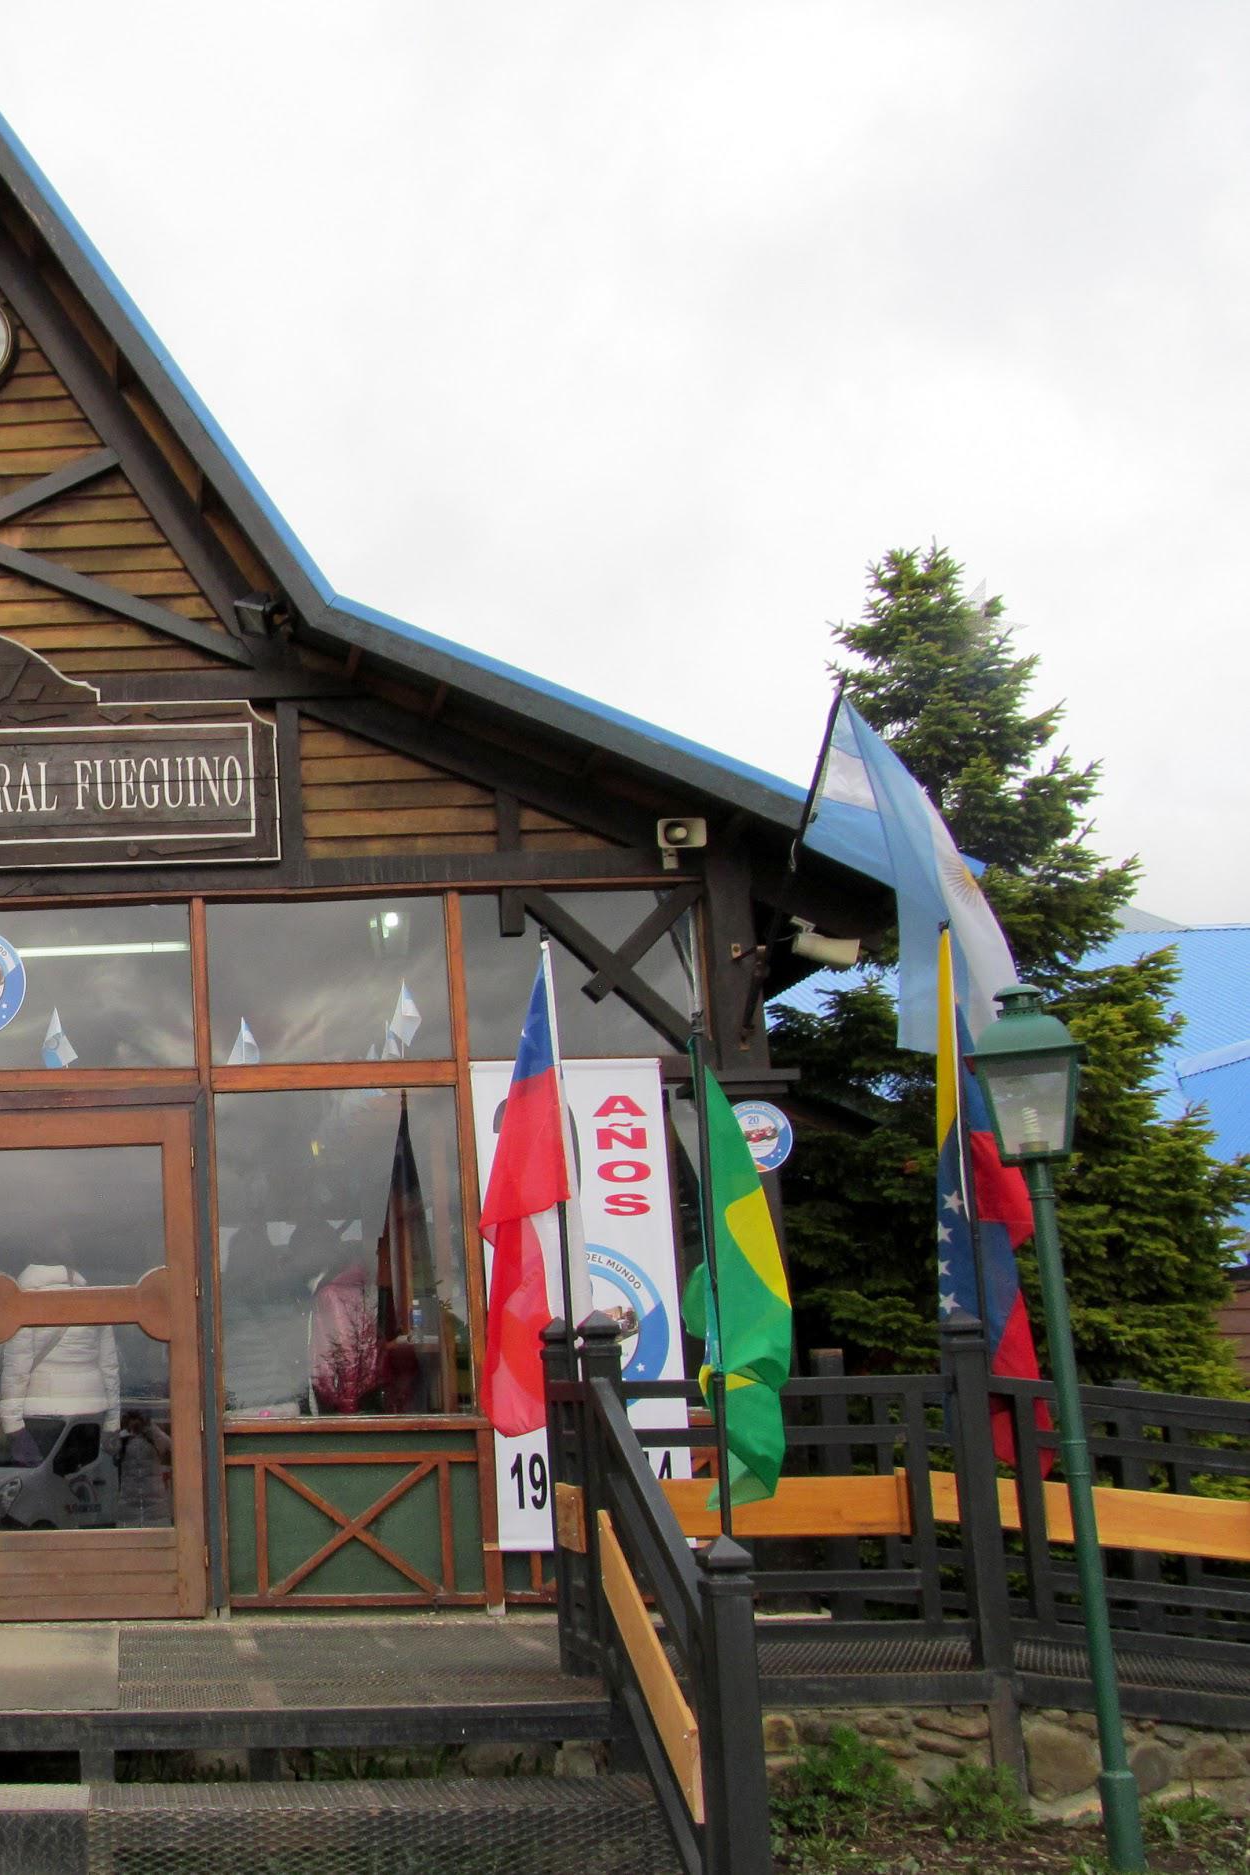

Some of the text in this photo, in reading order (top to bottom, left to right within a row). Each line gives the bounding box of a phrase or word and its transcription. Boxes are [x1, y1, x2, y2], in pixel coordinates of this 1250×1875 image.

[73, 755, 244, 811] FUEGUINO
[593, 1095, 652, 1217] AÑOS
[606, 1259, 642, 1290] MUNDO
